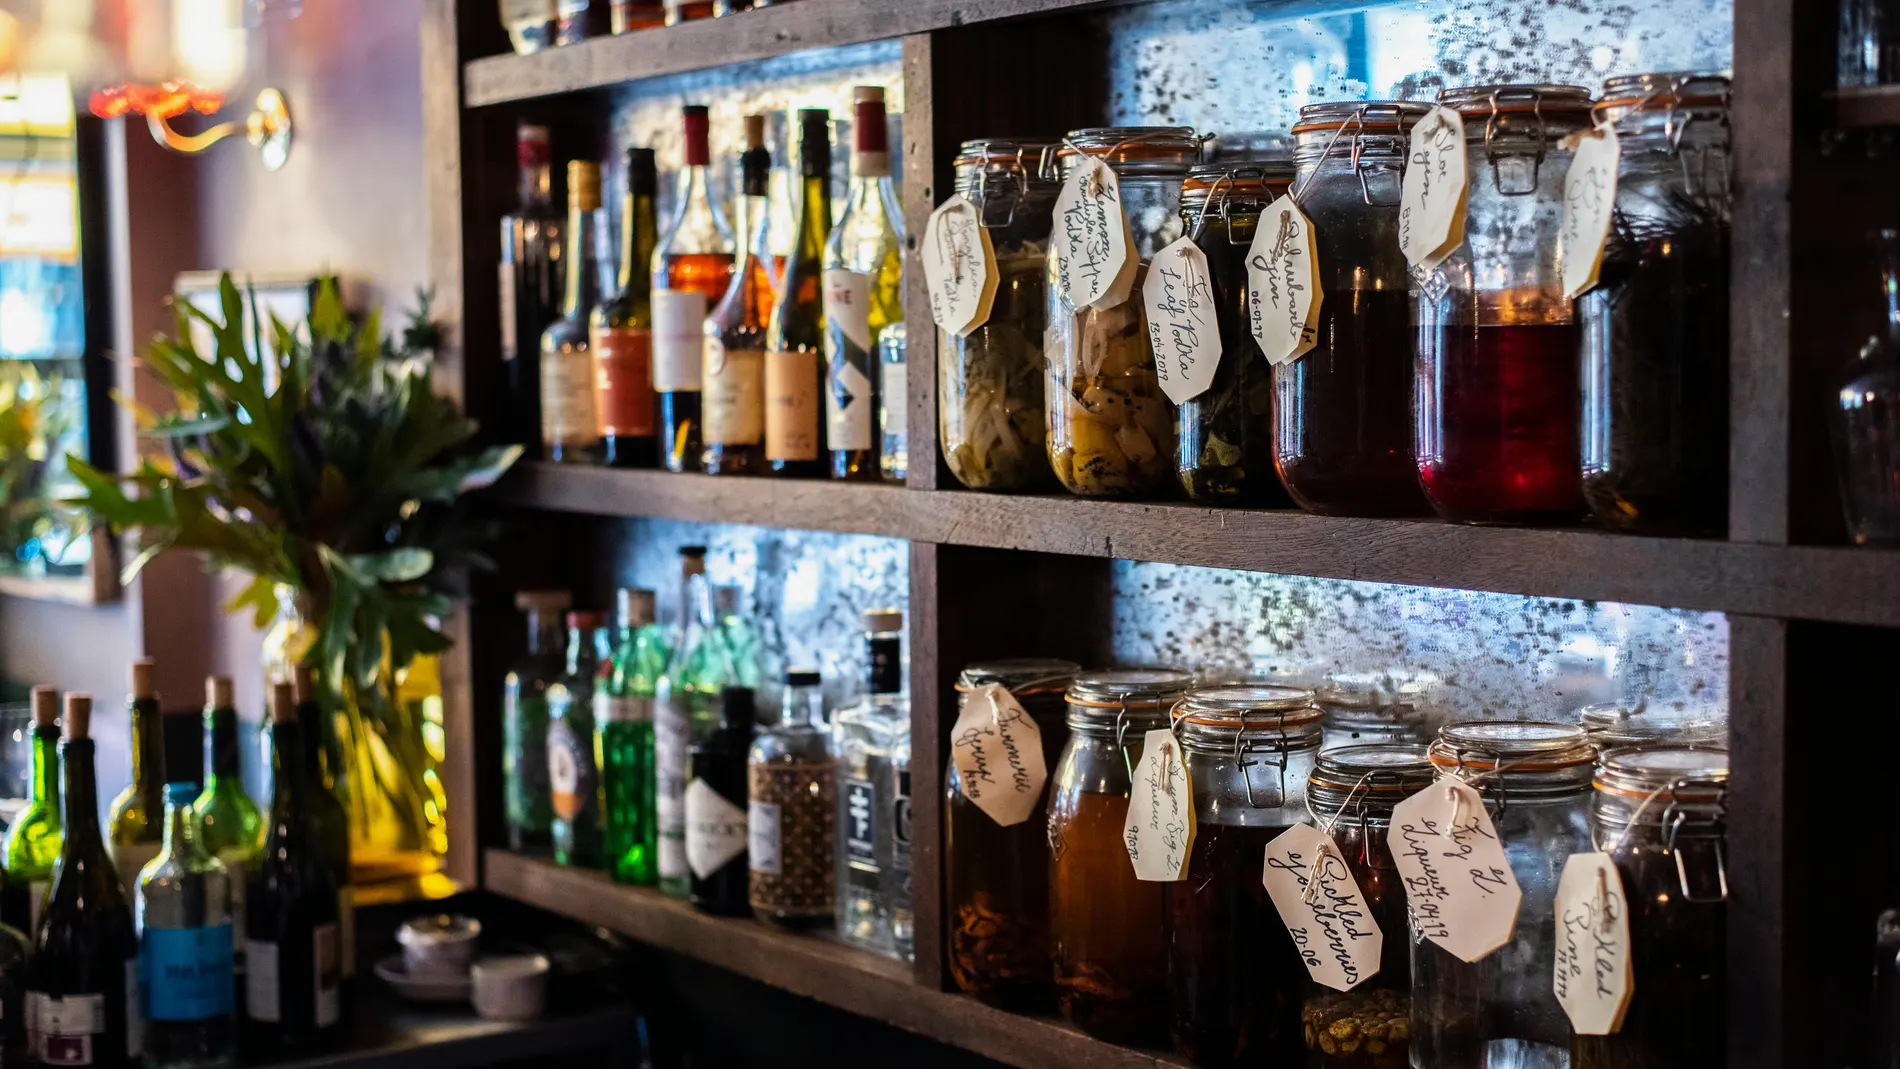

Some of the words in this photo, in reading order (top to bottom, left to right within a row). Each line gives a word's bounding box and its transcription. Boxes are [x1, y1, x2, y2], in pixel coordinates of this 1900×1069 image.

[1157, 267, 1187, 319] Leaf
[1144, 756, 1161, 831] Liqueur
[1401, 817, 1449, 901] Liqueur
[1312, 854, 1374, 942] Pickled
[1288, 926, 1323, 968] 20-06
